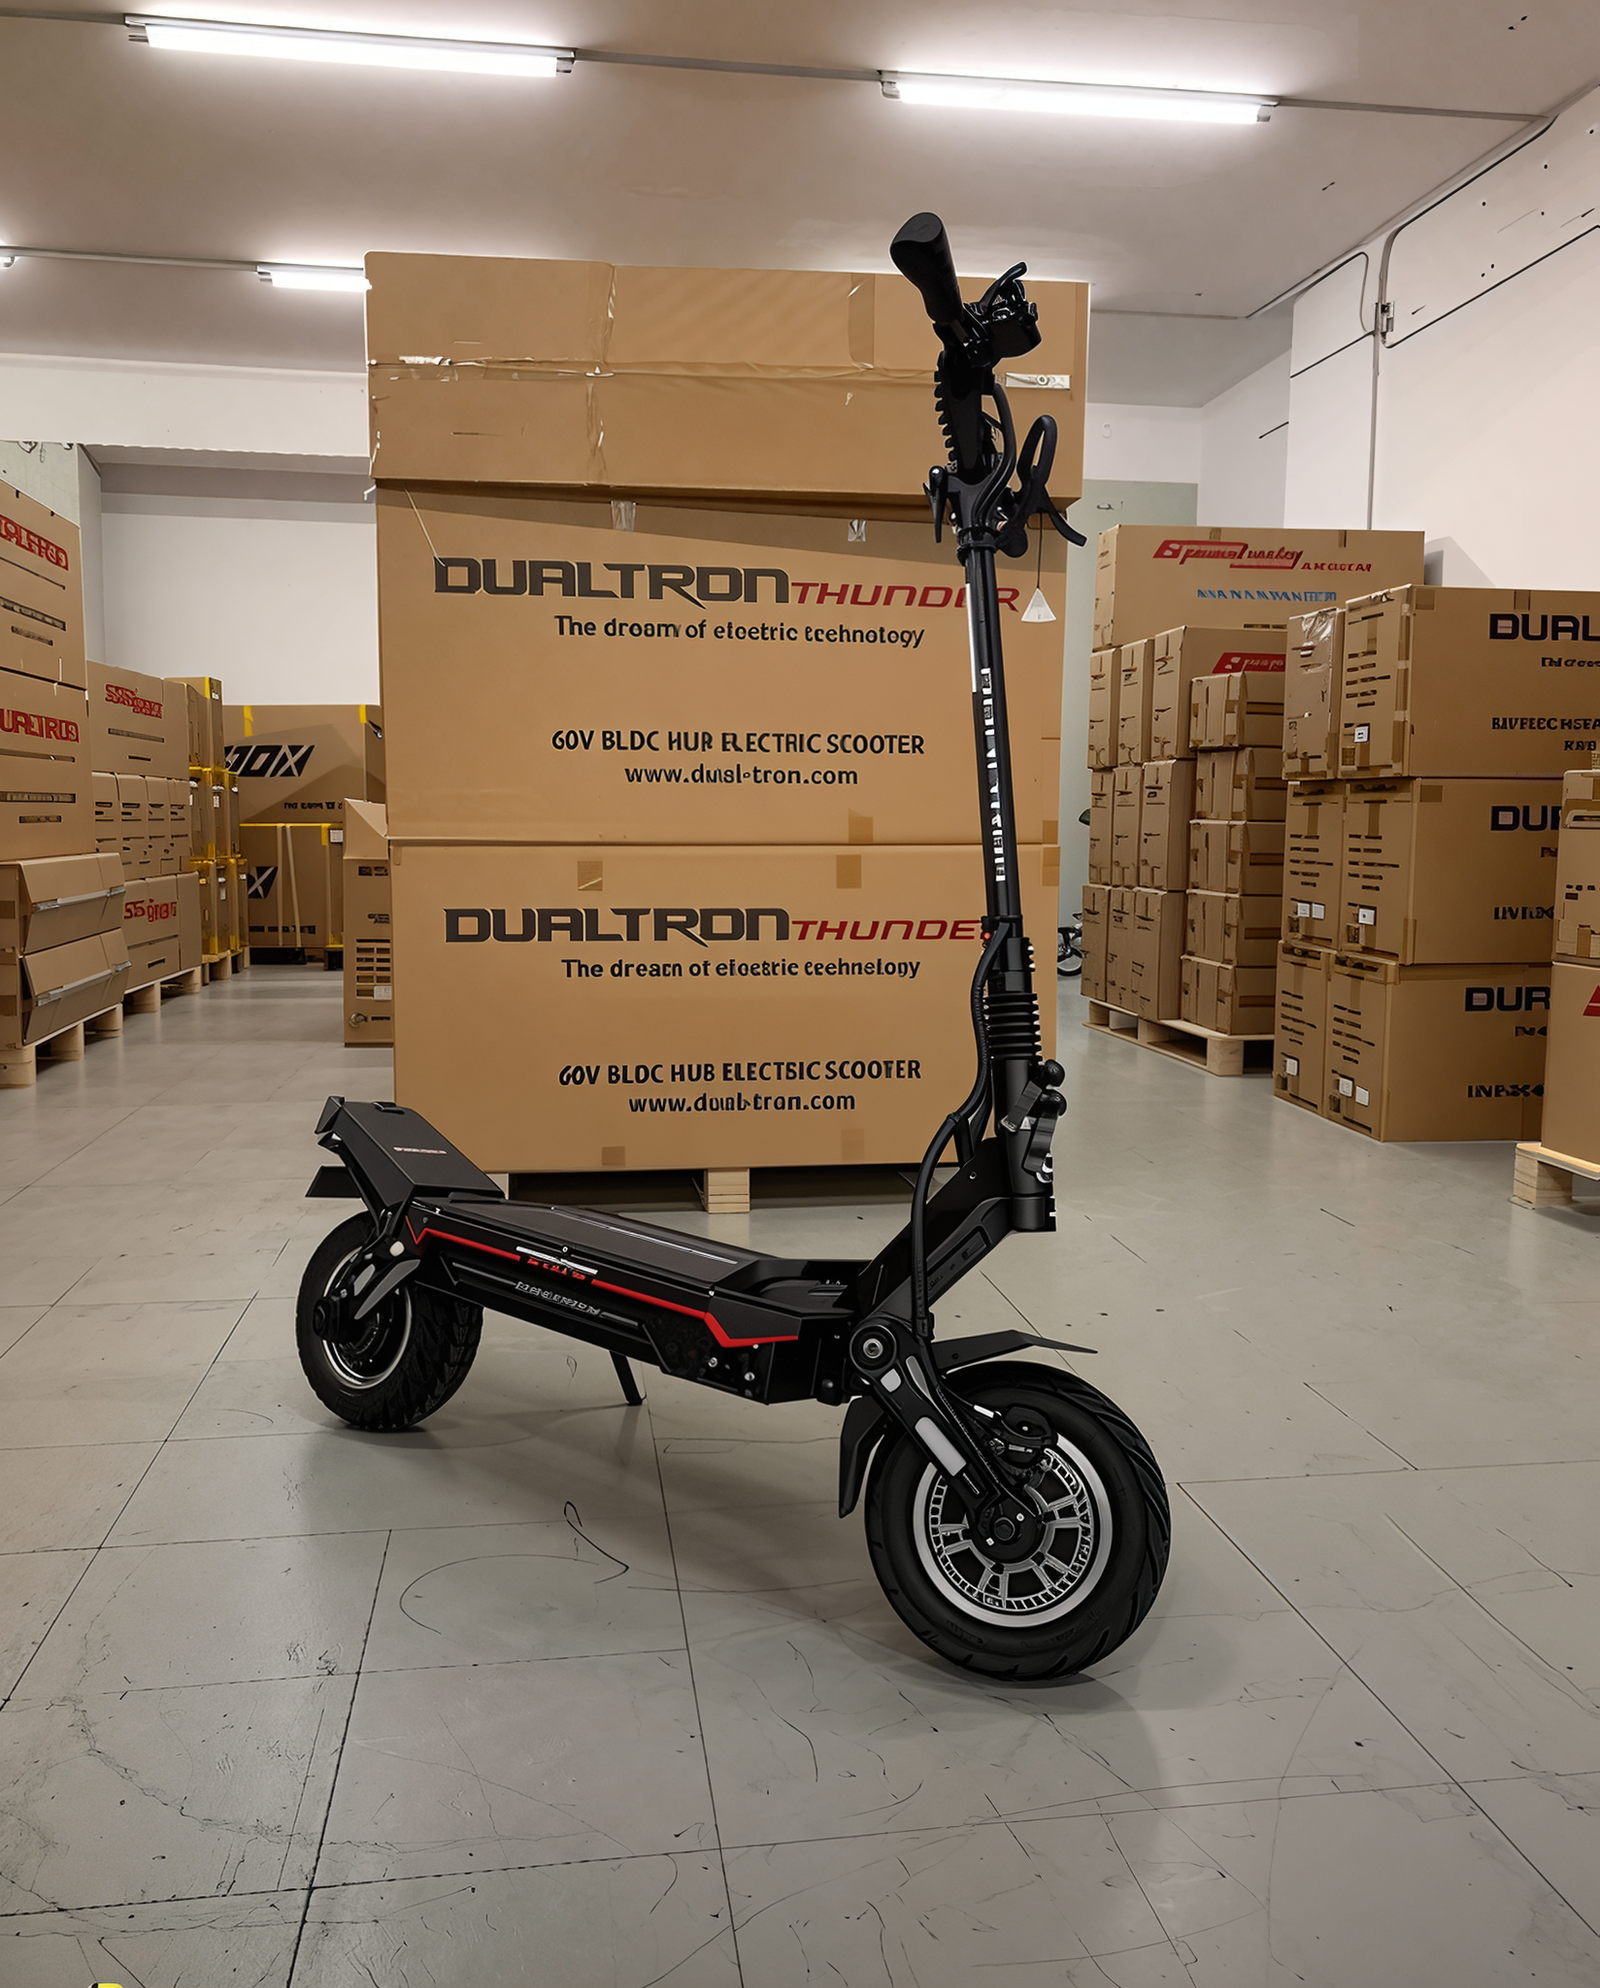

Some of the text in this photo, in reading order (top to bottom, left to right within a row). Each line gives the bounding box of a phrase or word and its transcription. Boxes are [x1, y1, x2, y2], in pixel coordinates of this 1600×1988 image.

[434, 556, 790, 610] DUALTRON
[554, 615, 597, 636] The
[685, 619, 707, 639] of
[1489, 613, 1600, 641] DUAL
[602, 730, 660, 751] BLDC
[827, 734, 925, 754] SCOOTER
[443, 908, 790, 948] DUALTRON
[561, 959, 604, 978] The
[608, 1064, 664, 1084] BLDC
[671, 1064, 715, 1083] HUB
[824, 1060, 921, 1080] SCOOTER
